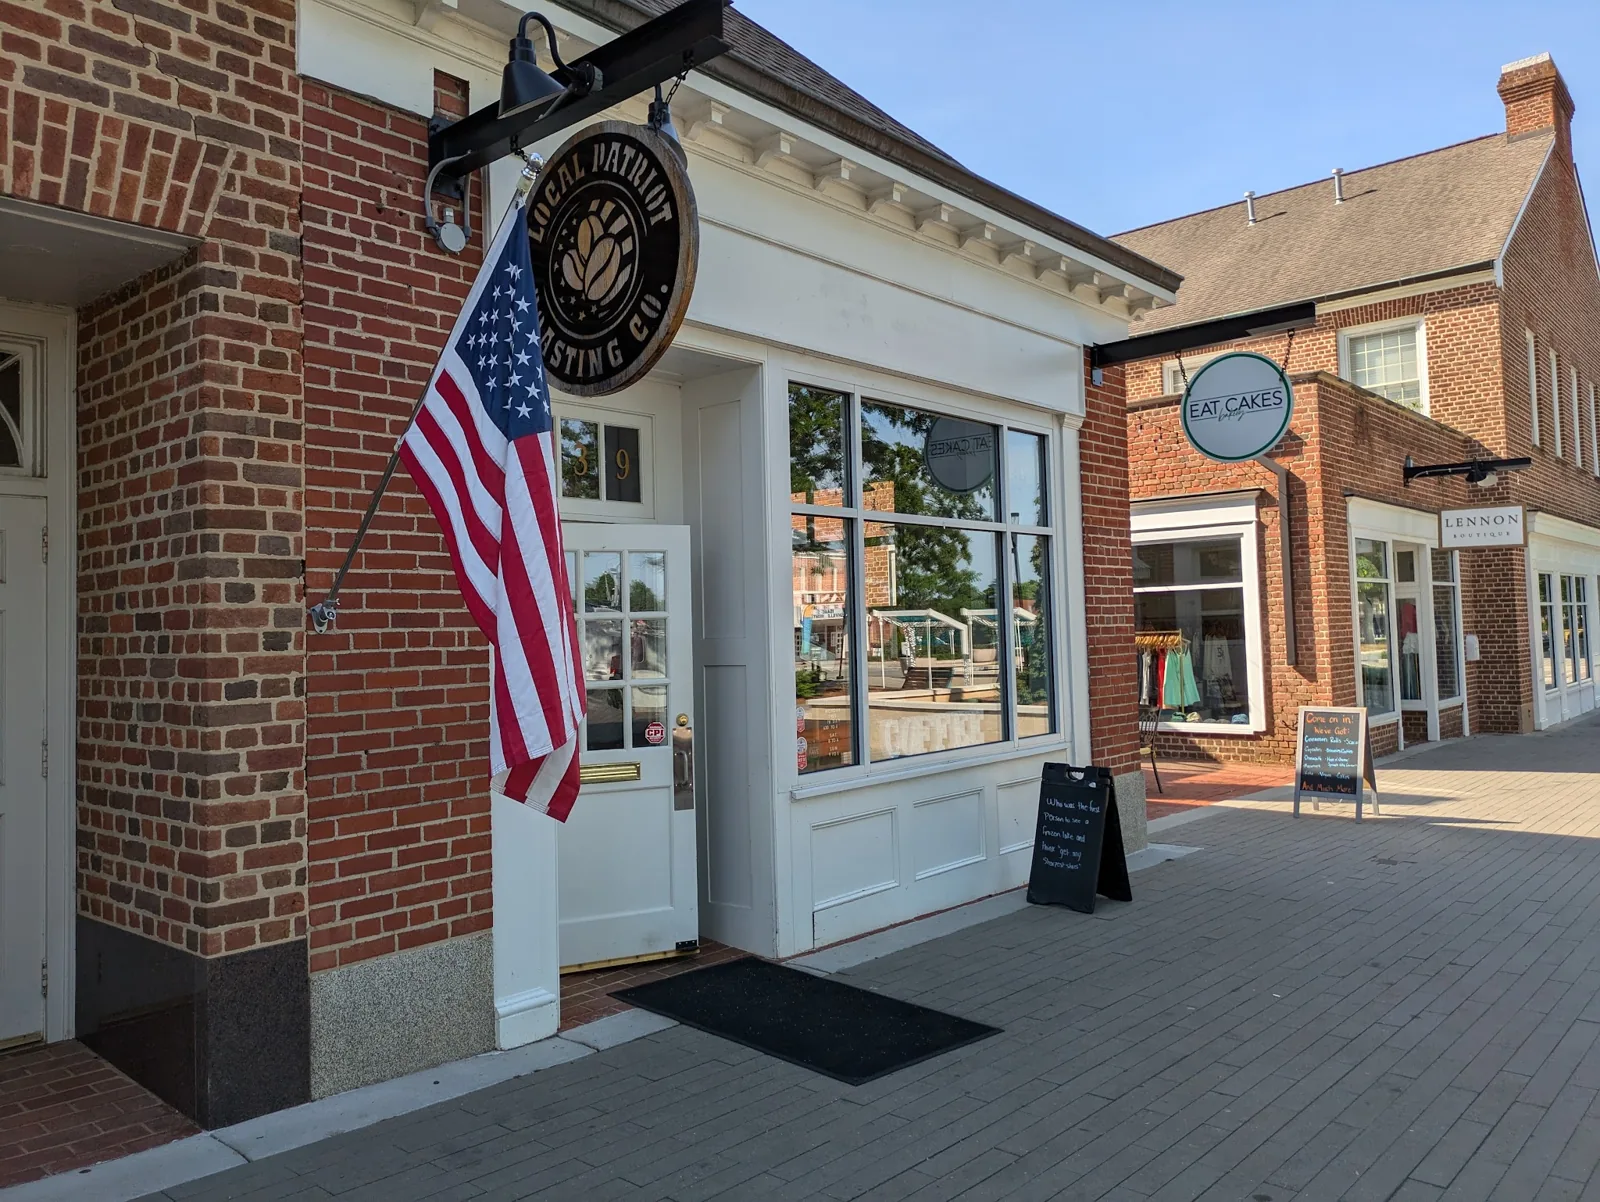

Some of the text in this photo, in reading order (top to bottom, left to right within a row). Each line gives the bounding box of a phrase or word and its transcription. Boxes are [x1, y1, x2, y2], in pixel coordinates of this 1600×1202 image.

[528, 141, 673, 244] LOCAL PATRIOT
[536, 284, 669, 377] ASTING CO.
[1190, 390, 1283, 419] EAT CAKES
[1445, 514, 1519, 528] LENNON
[1453, 531, 1511, 539] BOUTIQUE
[1306, 712, 1355, 724] Come on in!
[647, 729, 665, 737] CPI
[1302, 781, 1314, 791] And
[1317, 784, 1333, 792] Much
[1046, 798, 1063, 808] Who
[1078, 802, 1088, 811] the
[1076, 834, 1086, 843] and
